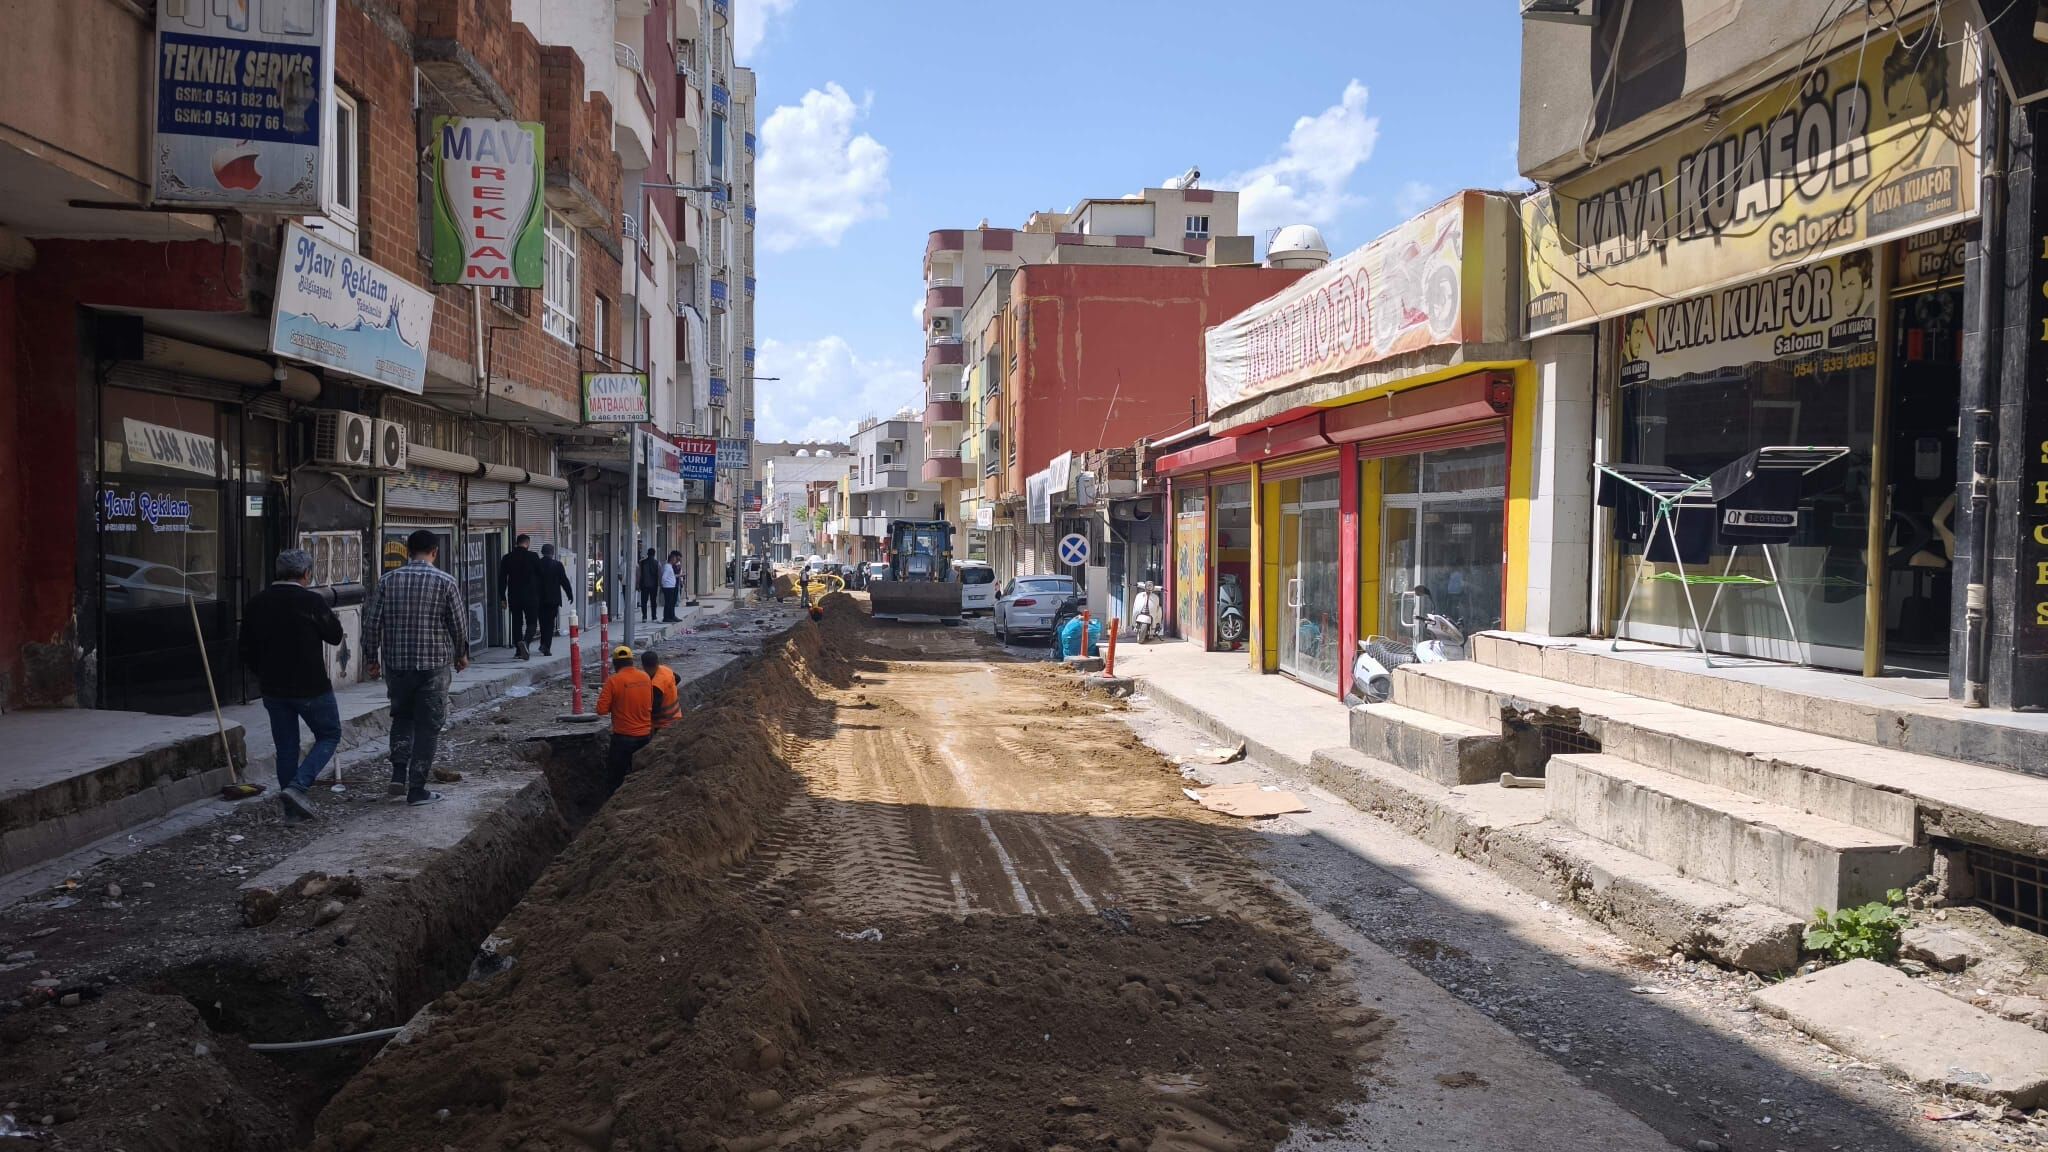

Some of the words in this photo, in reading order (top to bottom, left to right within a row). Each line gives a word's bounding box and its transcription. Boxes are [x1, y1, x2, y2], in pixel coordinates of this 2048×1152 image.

[216, 90, 237, 106] 541
[215, 111, 236, 127] 541
[1577, 164, 1669, 275] KAYA
[1677, 67, 1872, 241] KUAFÖR
[1873, 184, 1901, 214] KAYA
[1925, 196, 1952, 213] salonu
[466, 165, 510, 280] REKLAM
[1769, 205, 1857, 261] Salonu
[295, 236, 337, 279] Mavi
[341, 257, 388, 303] Reklam
[1300, 266, 1370, 368] MOTOR
[1656, 294, 1715, 354] KAYA
[1721, 263, 1833, 342] KUAFÖR
[1774, 330, 1823, 355] Salonu
[592, 376, 639, 394] KINAY
[678, 439, 712, 454] TİTİZ
[96, 490, 136, 520] Mavi
[139, 492, 189, 525] Reklam
